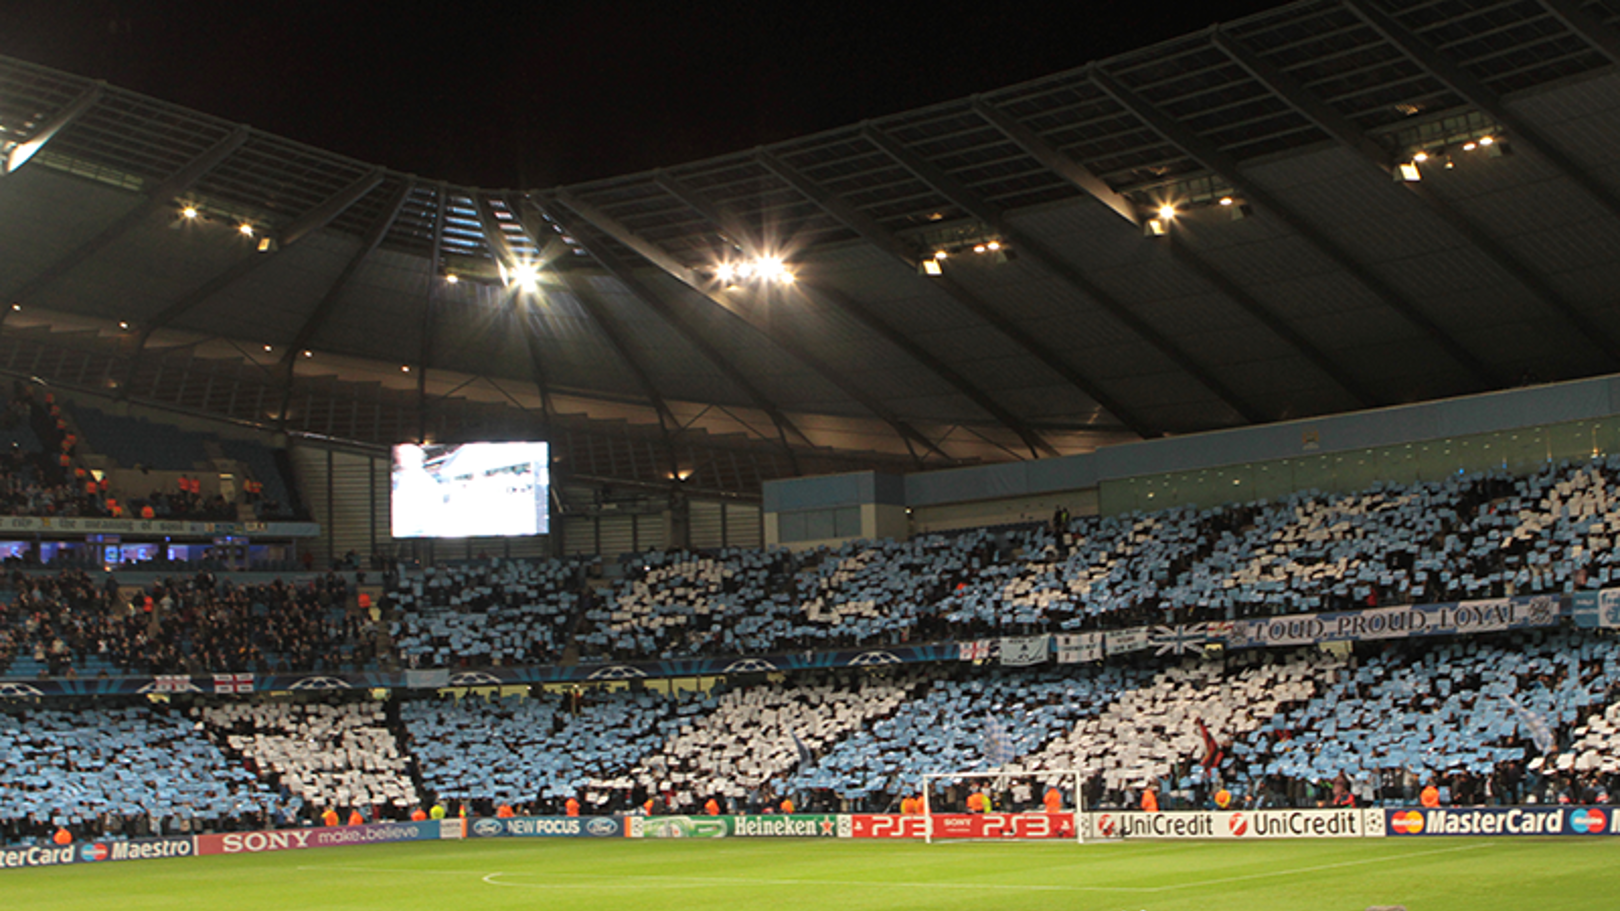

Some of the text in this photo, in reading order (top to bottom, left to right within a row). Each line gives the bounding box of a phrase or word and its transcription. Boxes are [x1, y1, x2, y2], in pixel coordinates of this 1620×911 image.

[1439, 602, 1521, 628] LOYAL
[507, 820, 580, 834] NEW FOCUS
[734, 816, 817, 836] Heineken
[873, 816, 934, 836] PS3
[983, 816, 1050, 836] PS3
[1121, 814, 1214, 835] UniCredit
[1254, 812, 1356, 834] UniCredit
[1426, 809, 1564, 833] MasterCard
[111, 840, 191, 860] Maestro
[222, 830, 313, 852] SONY
